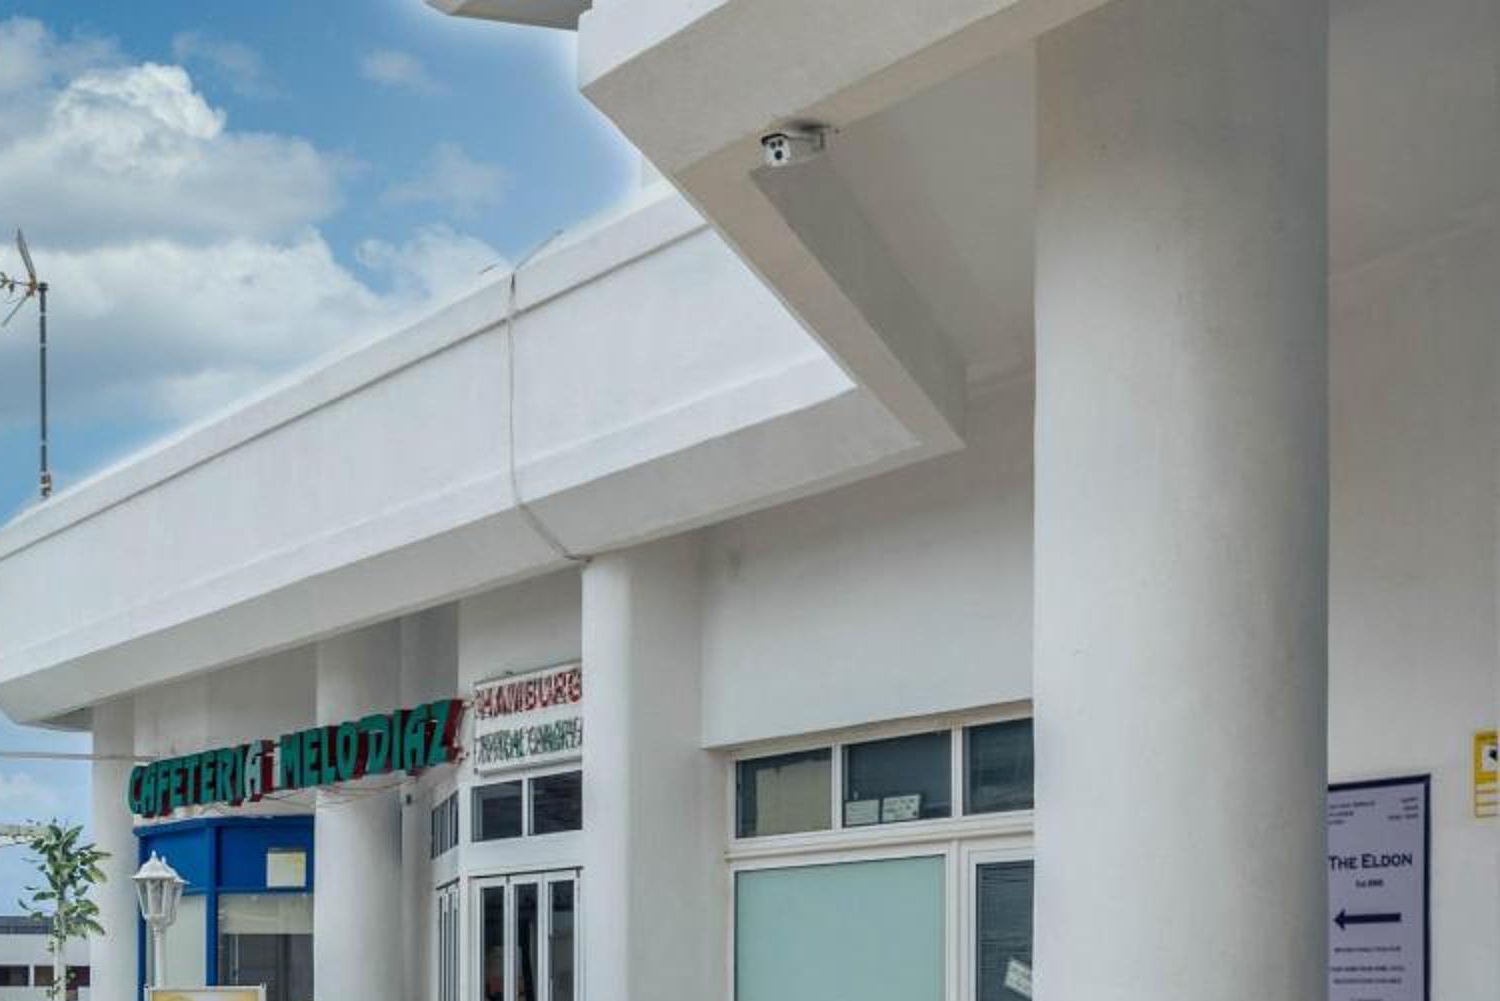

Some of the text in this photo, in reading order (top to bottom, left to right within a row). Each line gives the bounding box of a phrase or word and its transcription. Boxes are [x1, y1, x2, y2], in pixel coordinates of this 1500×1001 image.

[128, 741, 270, 817] CAFETERIA
[1328, 853, 1413, 870] THE ELDON
